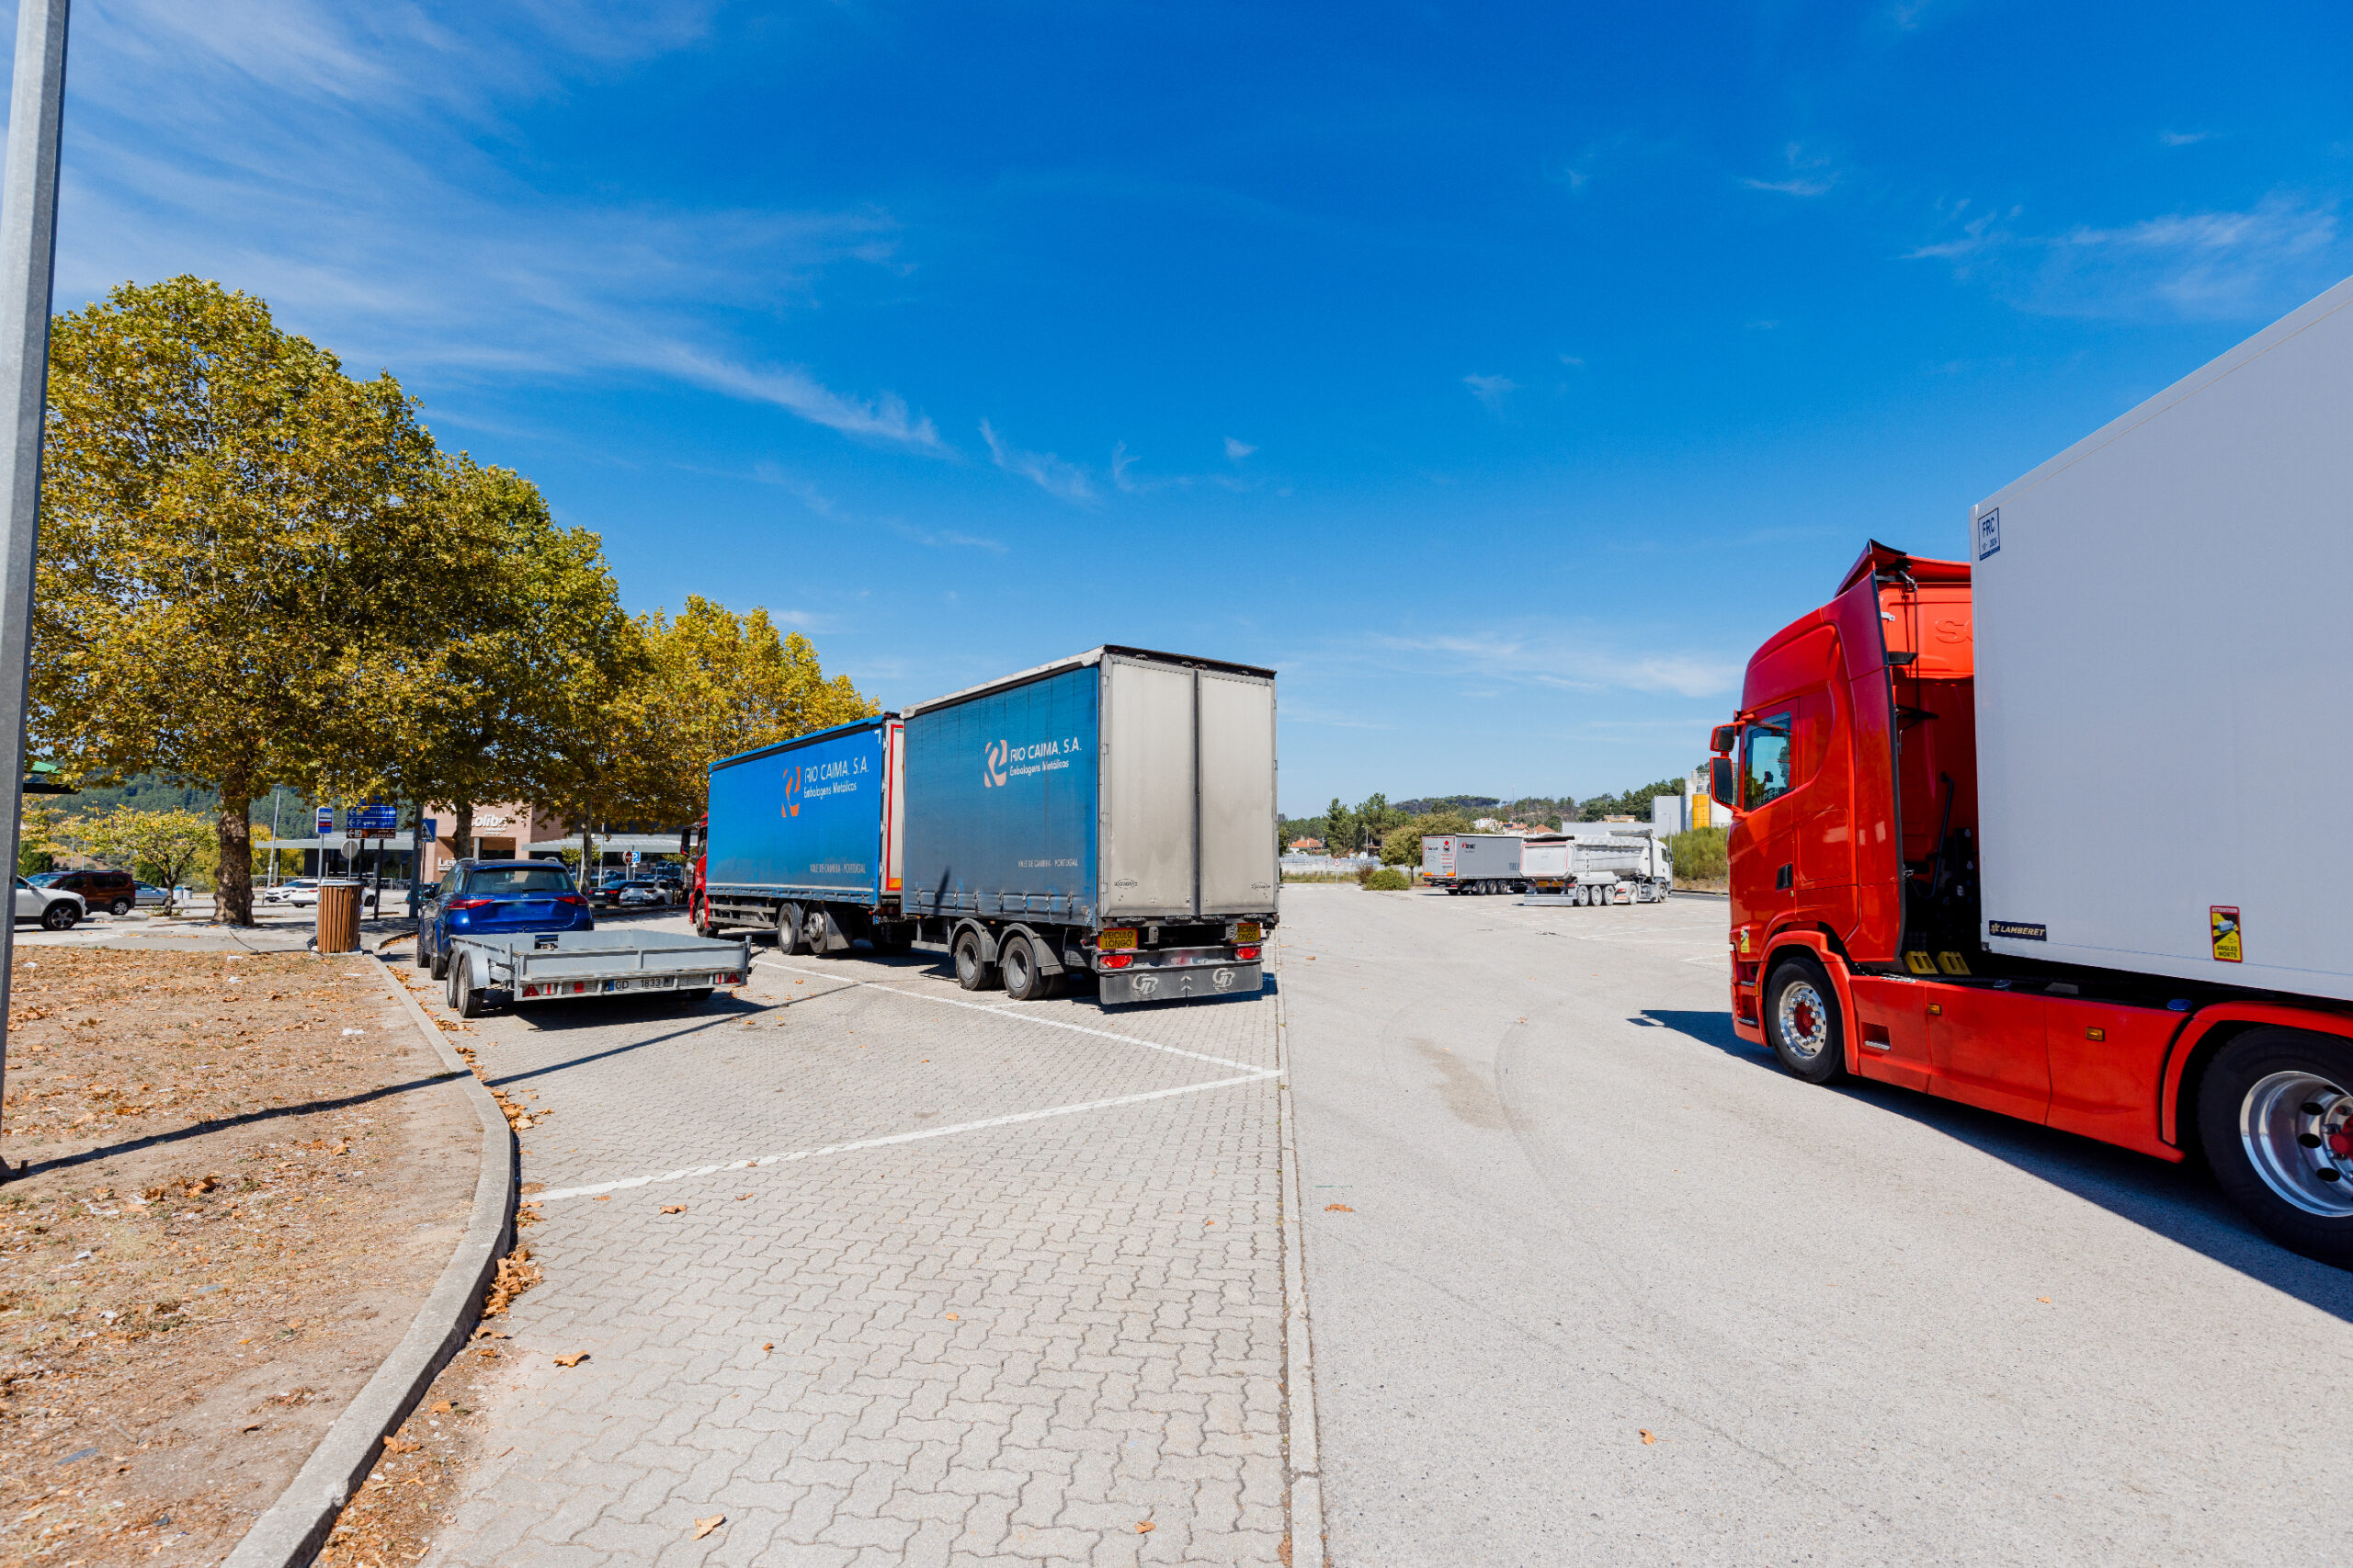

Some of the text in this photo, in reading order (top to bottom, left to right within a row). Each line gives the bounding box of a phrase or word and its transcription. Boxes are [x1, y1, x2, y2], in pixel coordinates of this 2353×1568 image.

[1982, 517, 1995, 538] FRC
[1010, 746, 1026, 763] RIO
[1063, 736, 1082, 754] S.A.
[804, 765, 819, 784] RIO
[853, 755, 870, 775] S.A.
[631, 852, 638, 863] P
[1054, 858, 1079, 868] PORTUGAL
[844, 863, 866, 874] PORTUGAL
[1237, 925, 1257, 934] EICULO
[2000, 926, 2045, 937] LAMBERET
[1103, 930, 1133, 940] VEICULO
[1238, 932, 1256, 941] ONGO
[1105, 938, 1132, 948] LONGO
[2217, 944, 2237, 952] ANGLES
[2218, 950, 2237, 959] MORTS
[615, 980, 630, 990] GD
[641, 978, 661, 988] 1833
